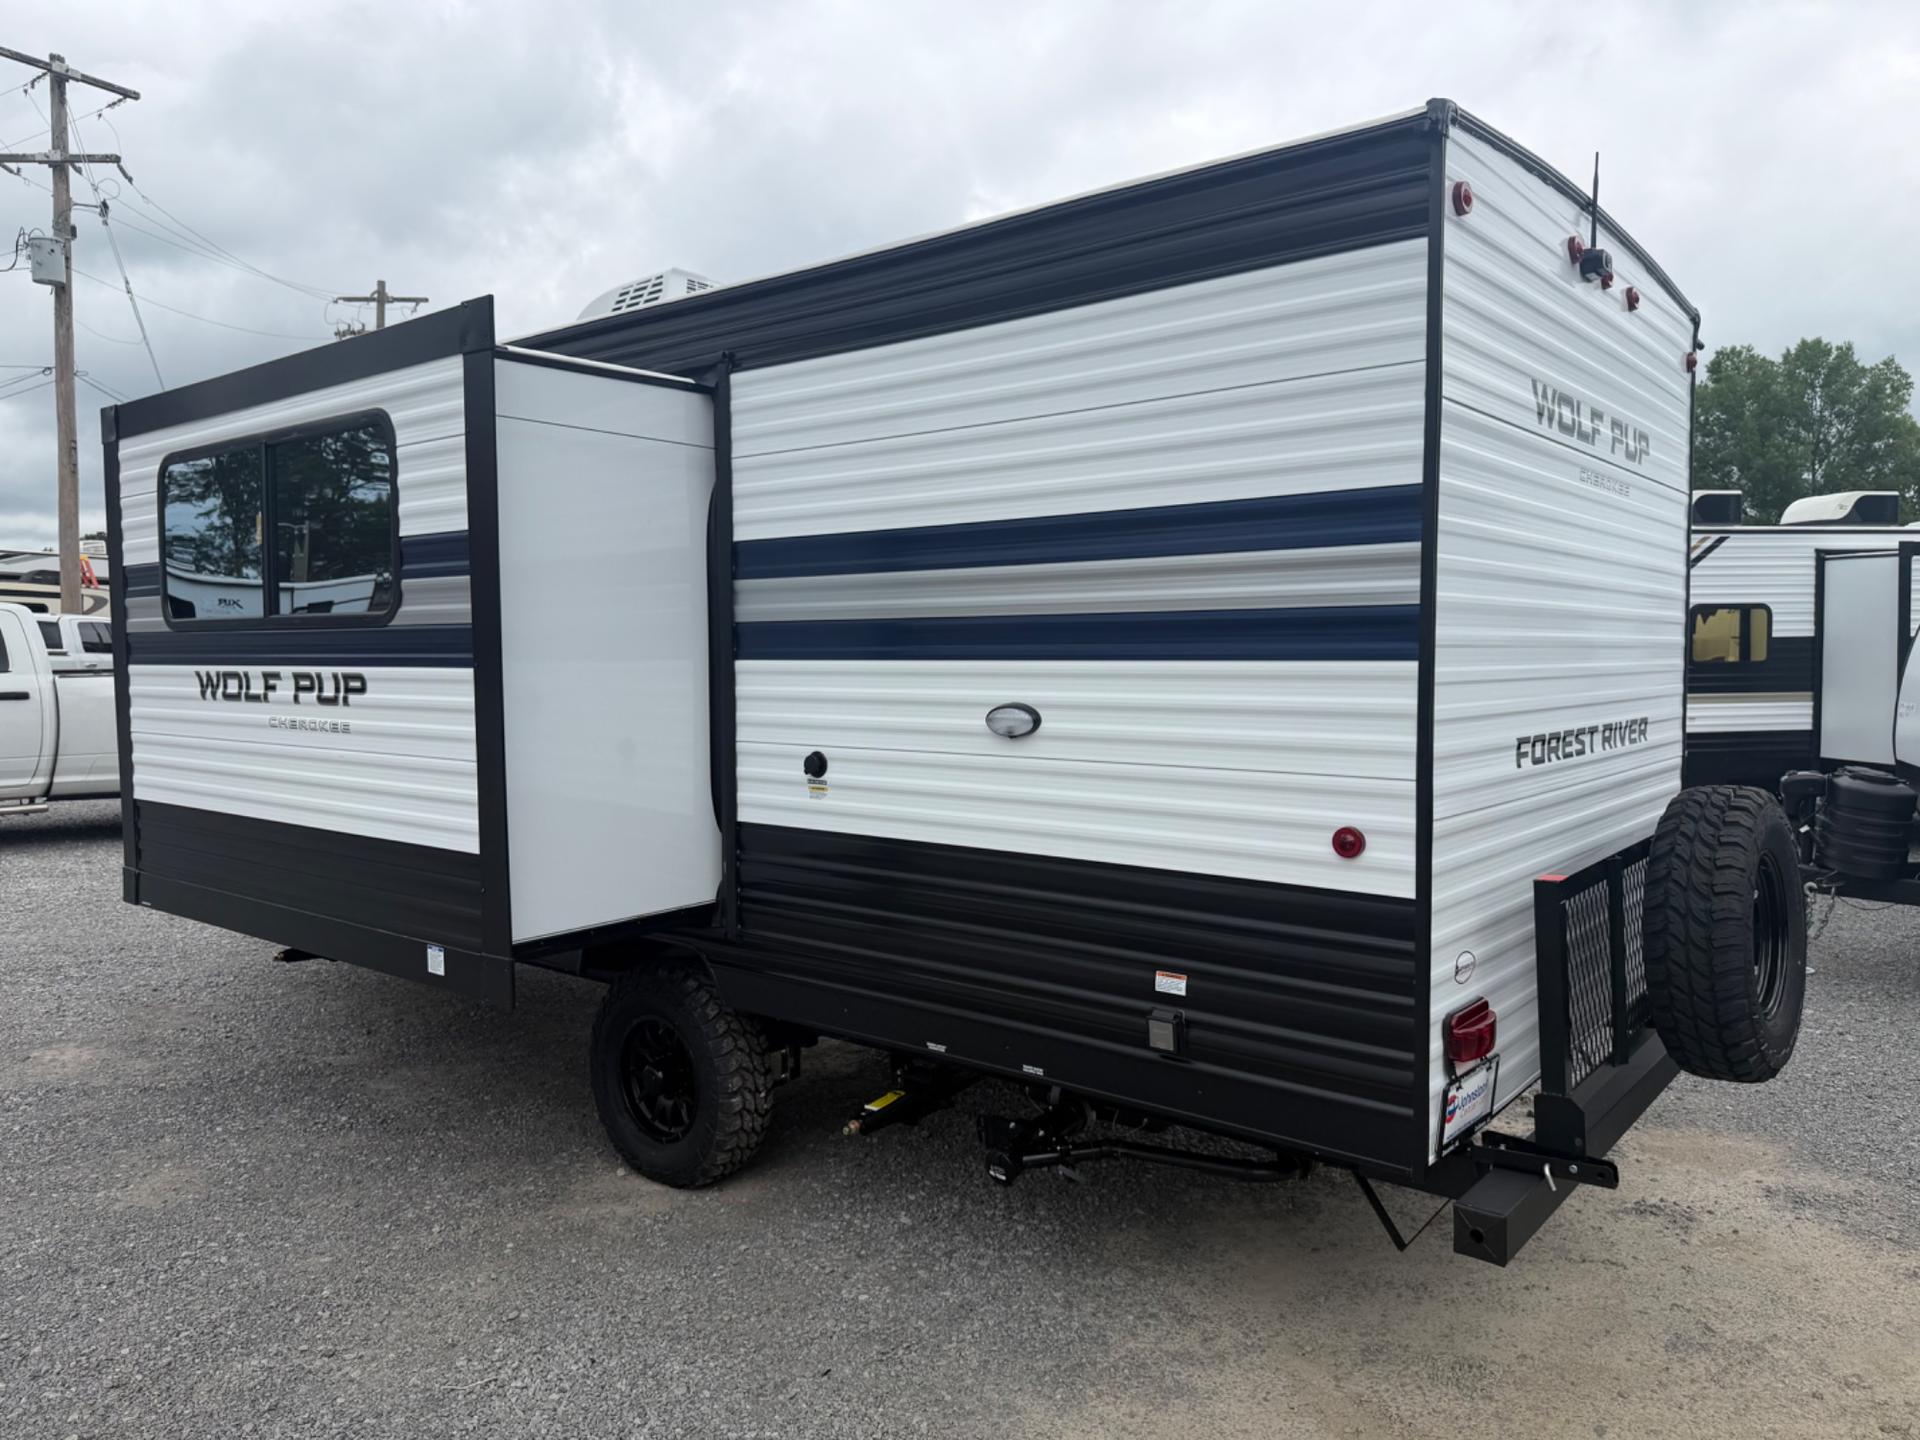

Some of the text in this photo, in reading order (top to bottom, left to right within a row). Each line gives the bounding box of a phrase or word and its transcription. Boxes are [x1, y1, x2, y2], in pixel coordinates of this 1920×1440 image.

[1531, 377, 1650, 465] WOLF PUP
[1579, 467, 1632, 497] CHEROKEE
[194, 670, 367, 707] WOLF PUP
[268, 716, 351, 734] CHEROKEE
[1516, 716, 1648, 769] FOREST RIVER
